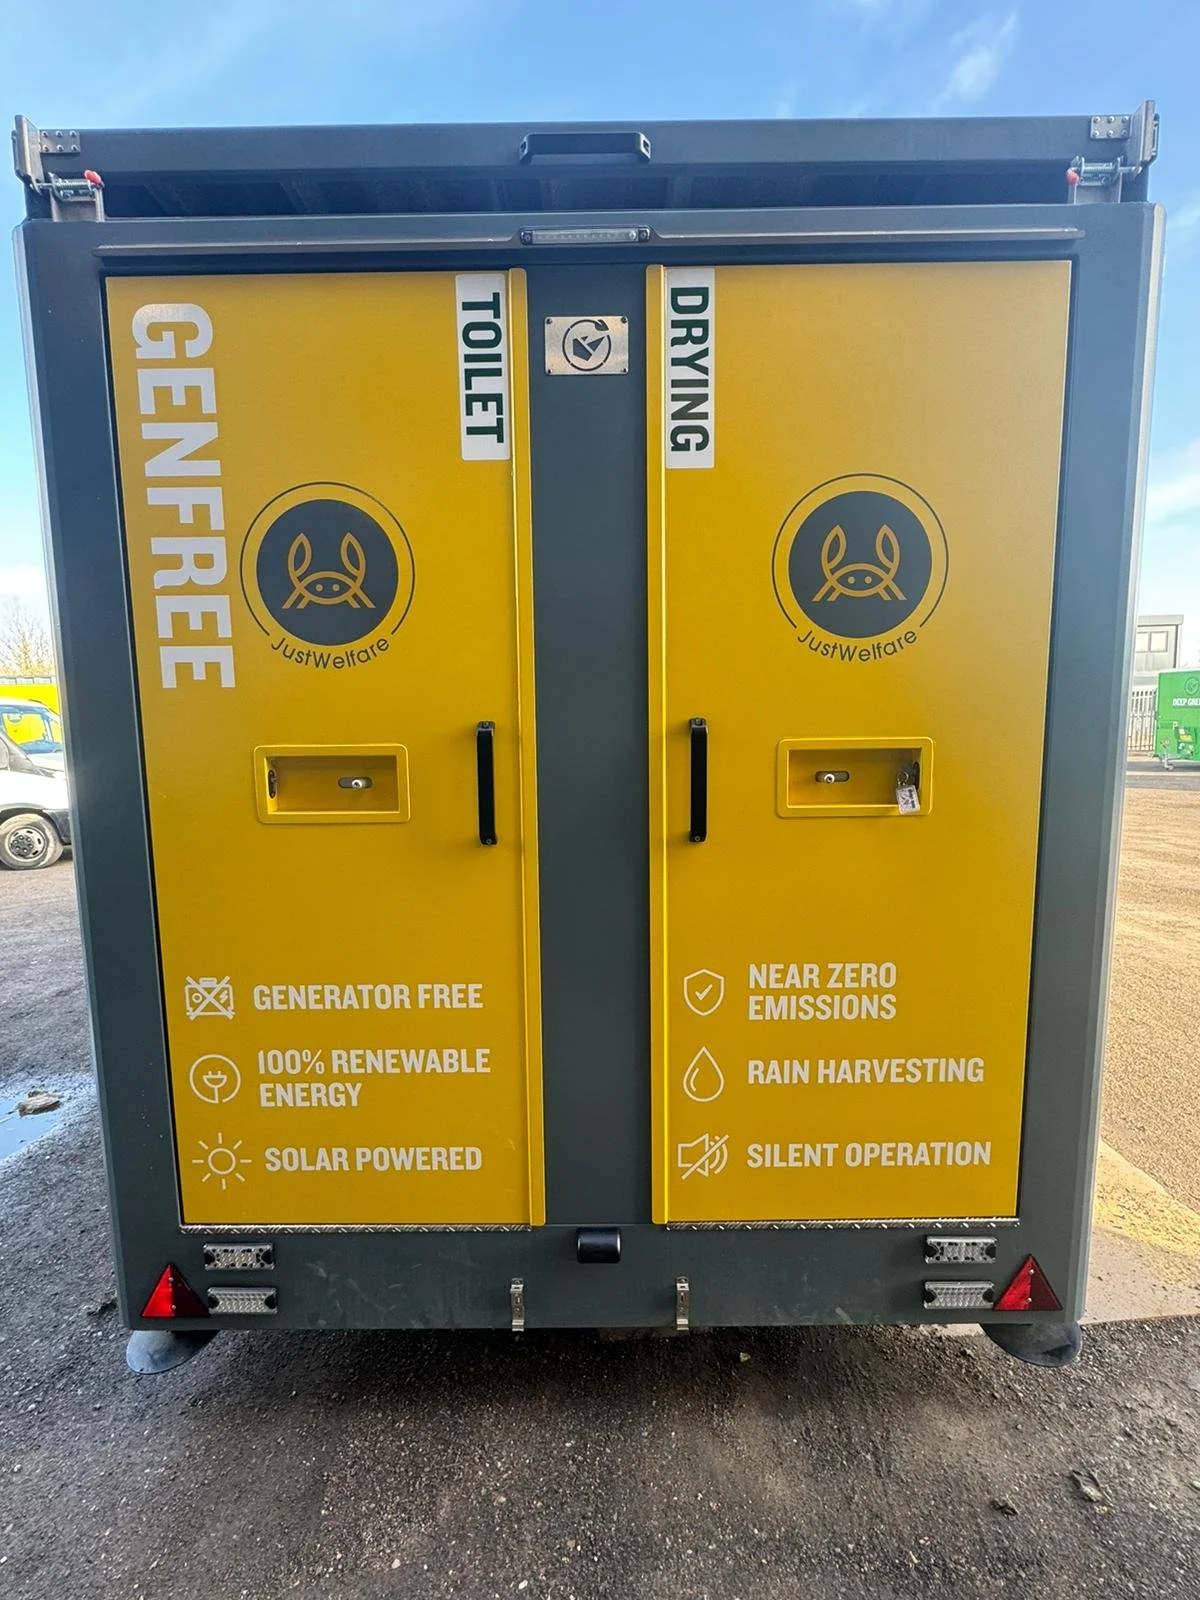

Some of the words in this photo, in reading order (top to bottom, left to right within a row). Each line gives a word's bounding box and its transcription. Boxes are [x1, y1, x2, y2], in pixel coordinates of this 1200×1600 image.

[461, 291, 505, 444] TOILET
[669, 286, 710, 453] DRYING
[132, 302, 236, 690] GENFREE
[270, 636, 391, 670] JustWelfare
[796, 628, 918, 663] JustWelfare
[748, 963, 820, 989] NEAR
[827, 962, 897, 988] ZERO
[253, 984, 411, 1010] GENERATOR
[418, 983, 484, 1009] FREE
[748, 994, 897, 1021] EMISSIONS
[258, 1049, 326, 1075] 100%
[331, 1048, 491, 1074] RENEWABLE
[747, 1059, 810, 1085] RAIN
[817, 1057, 985, 1084] HARVESTING
[259, 1082, 362, 1108] ENERGY
[264, 1147, 349, 1172] SOLAR
[355, 1146, 483, 1171] POWERED
[747, 1142, 839, 1168] SILENT
[845, 1141, 992, 1167] OPERATION
